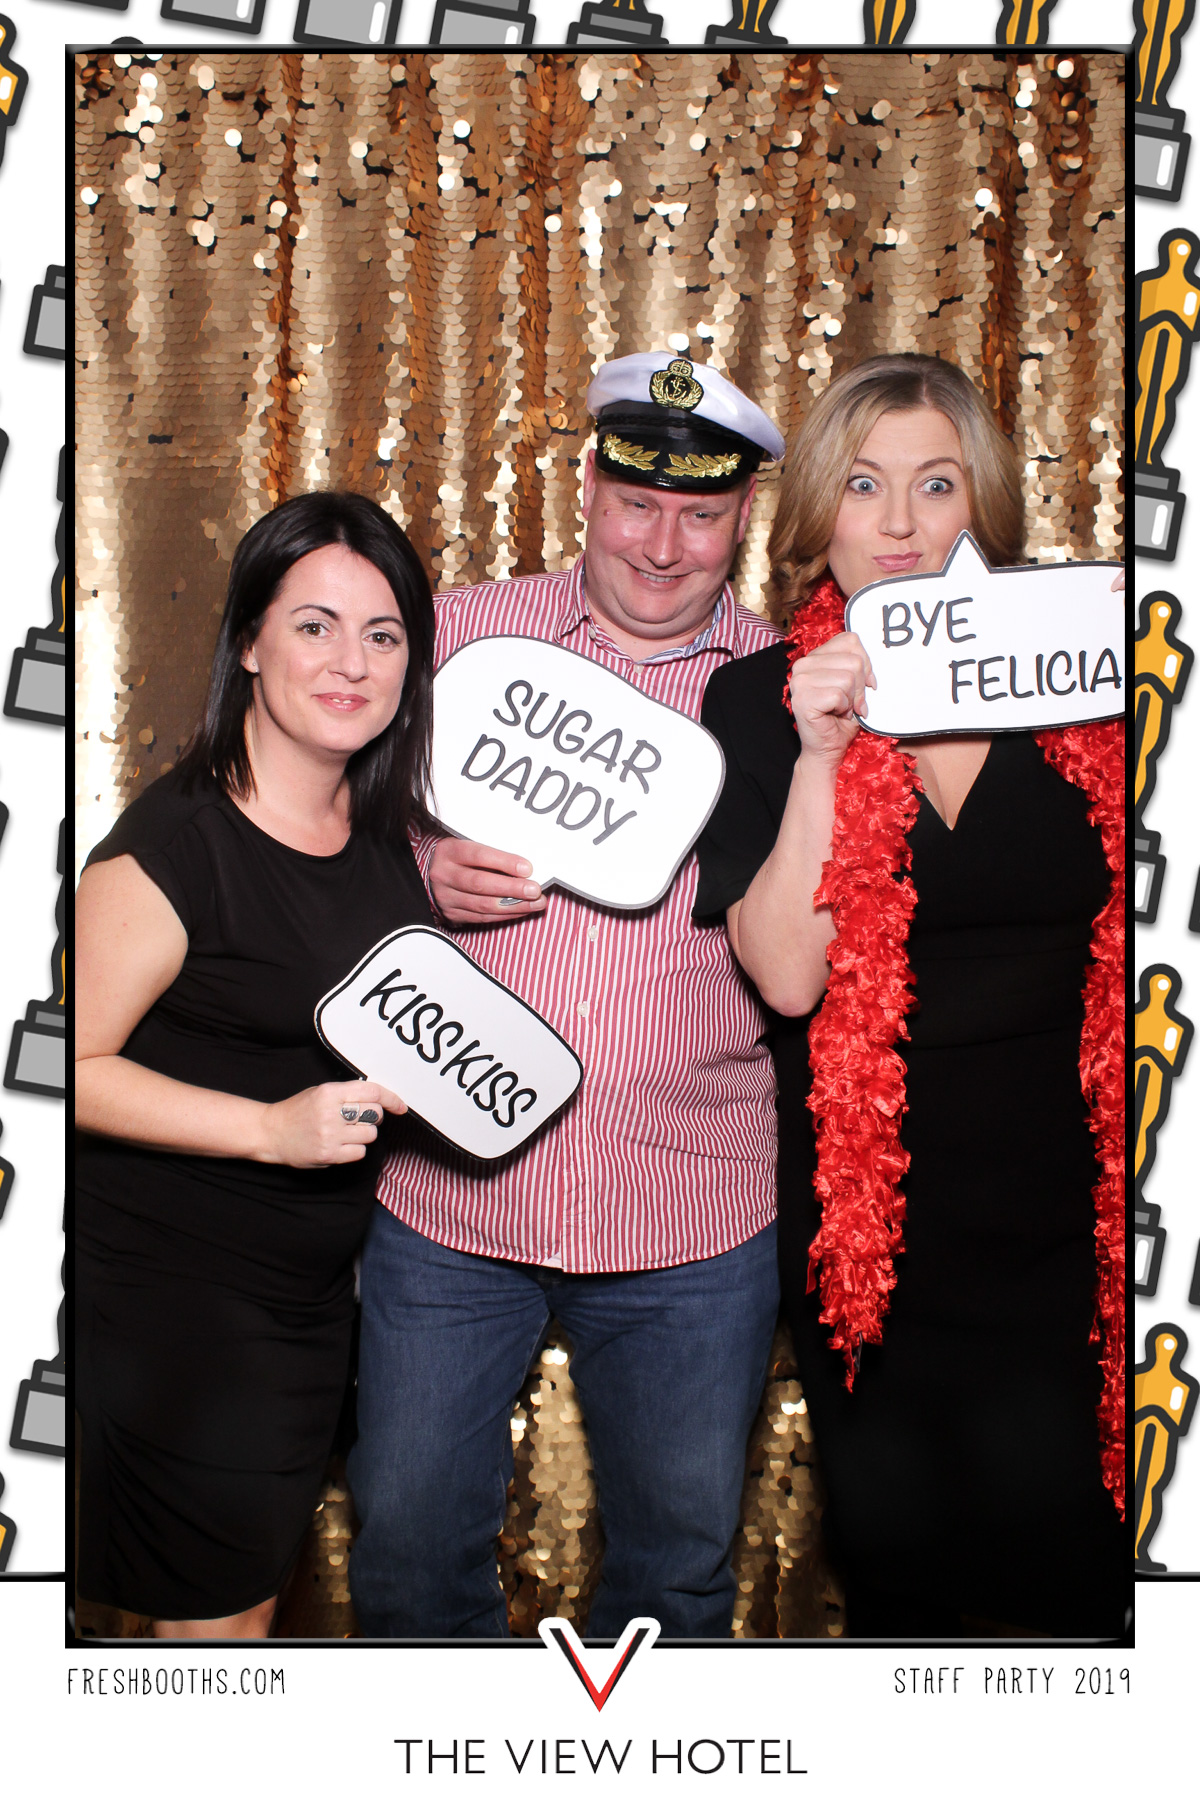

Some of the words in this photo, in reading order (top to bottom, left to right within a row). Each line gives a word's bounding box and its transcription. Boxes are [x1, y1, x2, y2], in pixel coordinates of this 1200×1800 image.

[882, 597, 977, 648] BYE
[948, 647, 1122, 704] FELICIA
[492, 679, 663, 794] SUGAR
[460, 733, 638, 846] DADDY
